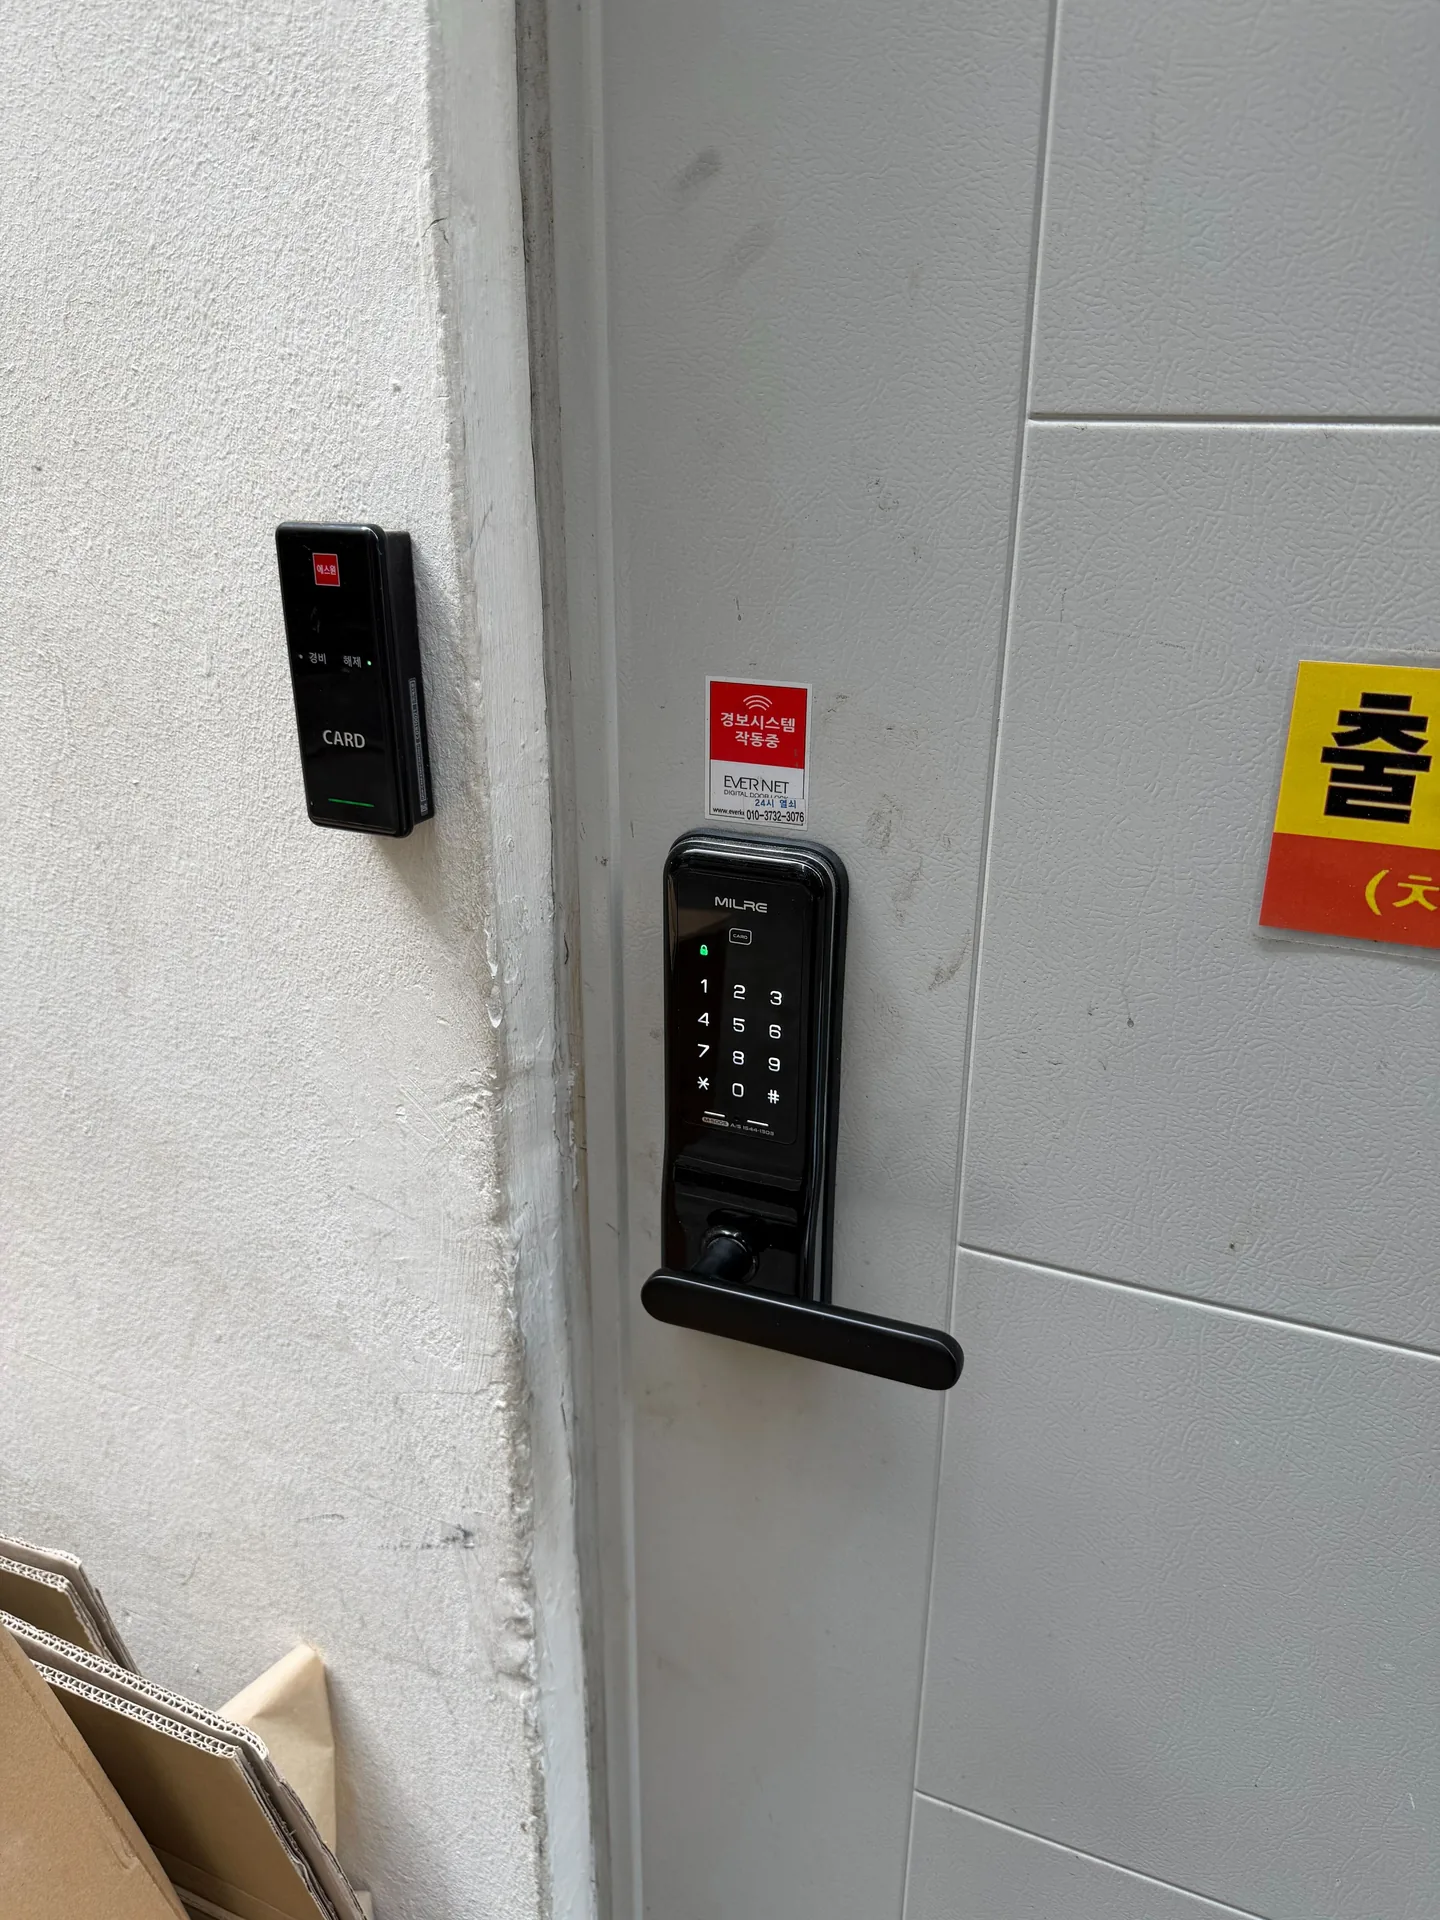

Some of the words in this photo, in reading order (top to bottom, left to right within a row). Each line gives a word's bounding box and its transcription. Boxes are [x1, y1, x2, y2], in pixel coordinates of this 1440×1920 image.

[316, 564, 337, 576] 에스원
[308, 652, 327, 665] 경비
[343, 655, 362, 668] 해제
[720, 712, 796, 733] 경보시스템
[322, 729, 366, 749] CARD
[734, 731, 780, 749] 작동중
[723, 789, 748, 798] DIGITAL
[755, 798, 774, 808] 24시
[780, 799, 796, 809] 열쇠
[746, 809, 805, 823] 010-3732-3076
[714, 896, 768, 914] MILRE
[700, 978, 708, 994] 1
[733, 984, 746, 1000] 2
[769, 990, 783, 1006] 3
[697, 1012, 710, 1027] 4
[732, 1017, 745, 1034] 5
[769, 1024, 782, 1040] 6
[697, 1043, 710, 1059] 7
[732, 1050, 745, 1066] 8
[768, 1057, 781, 1073] 9
[732, 1082, 744, 1098] 0
[767, 1089, 780, 1104] #
